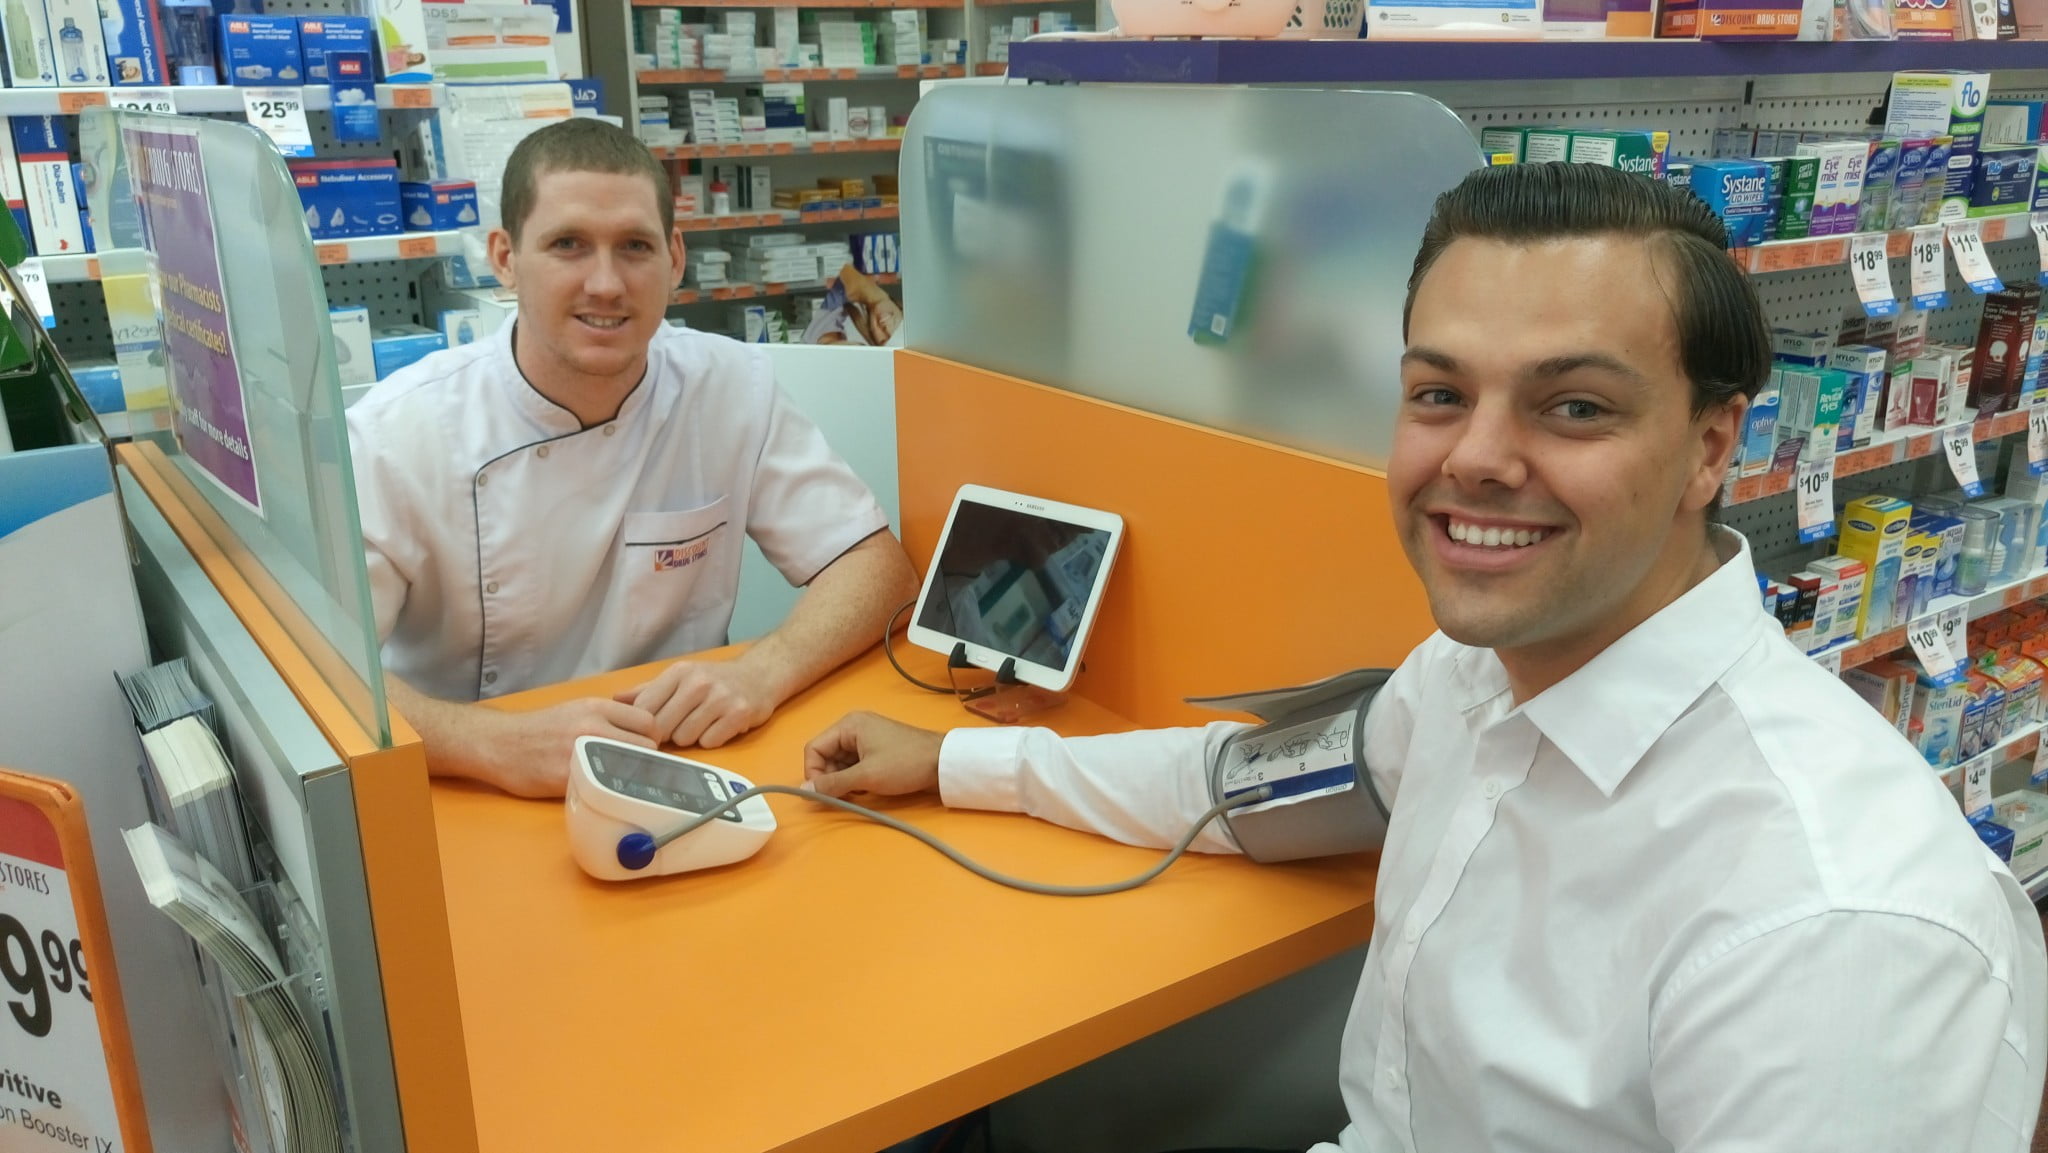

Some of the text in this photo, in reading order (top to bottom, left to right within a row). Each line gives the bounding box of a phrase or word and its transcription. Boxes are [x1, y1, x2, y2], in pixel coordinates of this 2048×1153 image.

[1721, 13, 1799, 25] DISCOUNT DRUG STORES
[339, 62, 361, 72] ABLE
[1961, 80, 1981, 108] flo
[1617, 153, 1658, 173] Systane
[1824, 159, 1839, 171] Eye
[1847, 157, 1863, 171] Eye
[296, 175, 317, 184] ABLE
[357, 172, 393, 183] Accessory
[1821, 172, 1839, 182] mist
[1843, 170, 1861, 181] mist
[53, 164, 66, 204] Dia-Balm
[1721, 173, 1766, 201] Systane
[224, 428, 249, 461] details
[674, 537, 709, 560] DISCOUNT
[1343, 752, 1348, 762] 1
[1299, 762, 1306, 771] 2
[1257, 771, 1264, 781] 3
[20, 1107, 90, 1151] Booster
